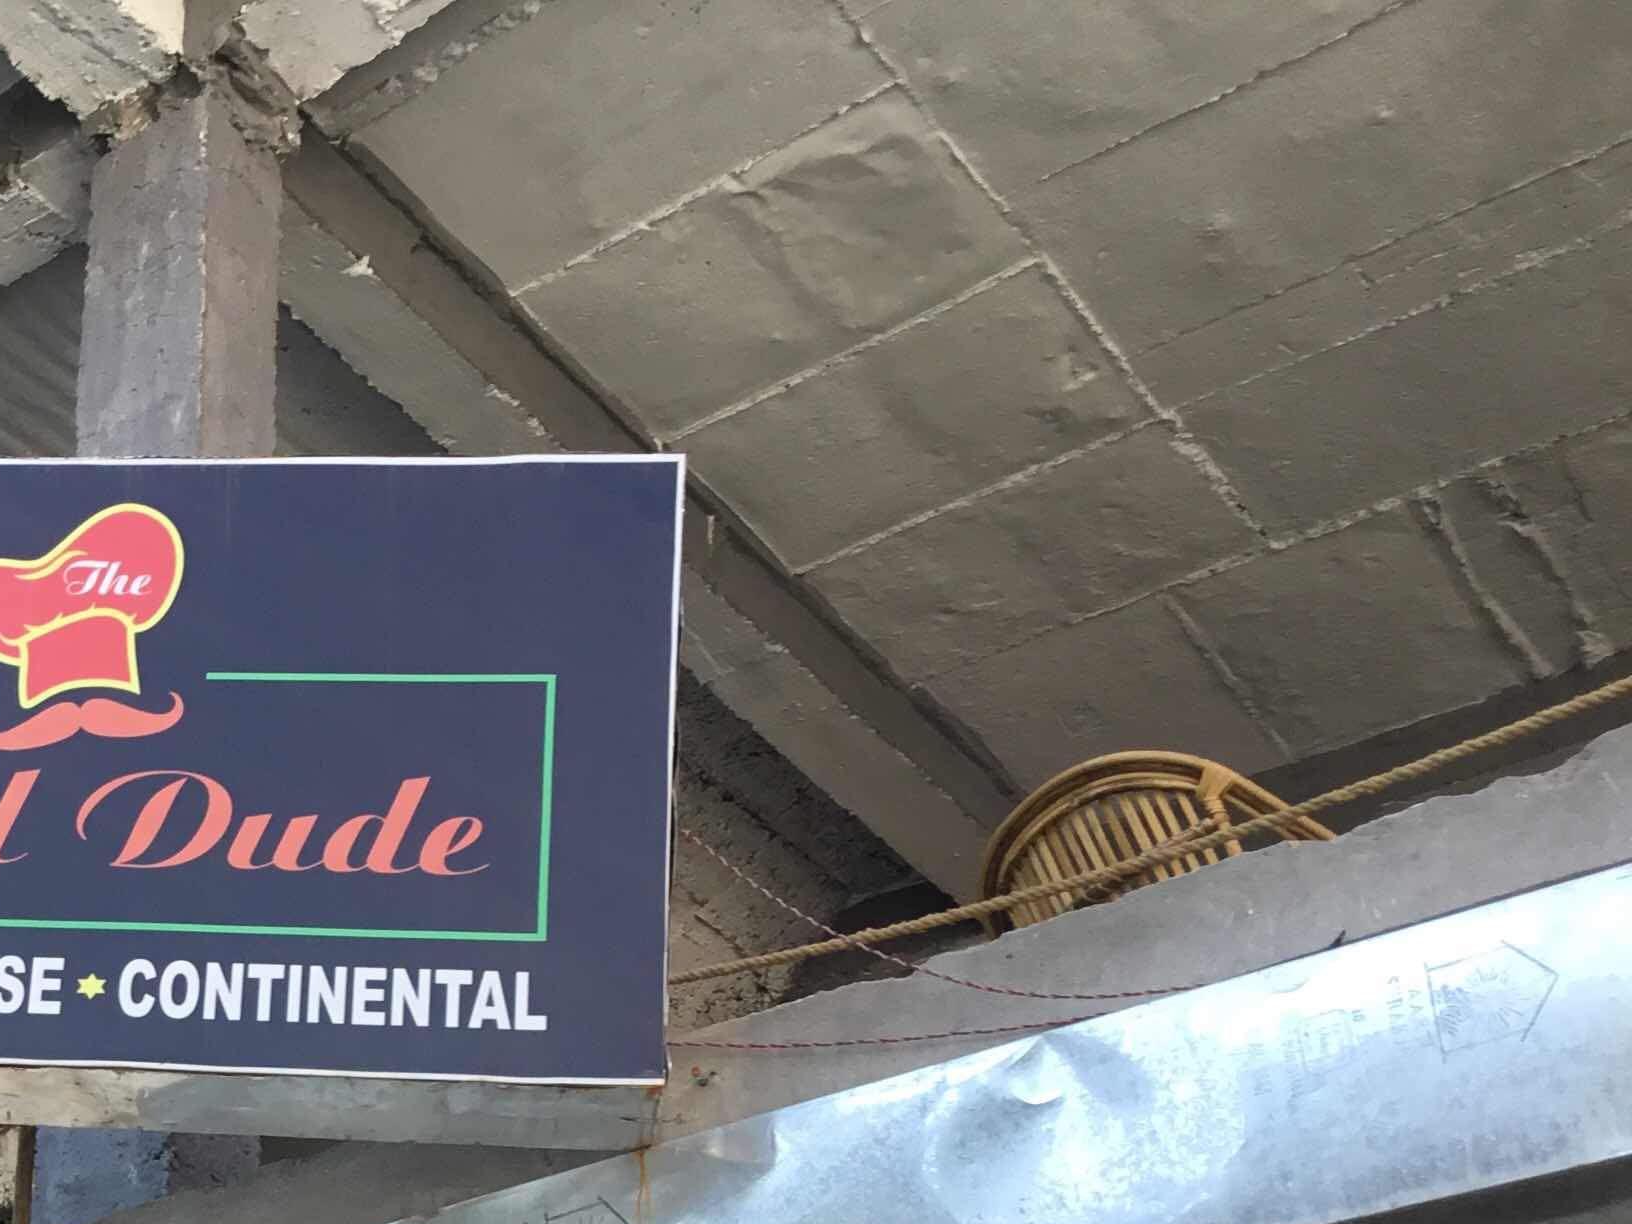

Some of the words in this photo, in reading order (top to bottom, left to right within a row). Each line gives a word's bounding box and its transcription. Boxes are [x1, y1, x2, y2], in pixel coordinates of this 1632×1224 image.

[63, 559, 153, 597] The
[75, 770, 489, 876] Dude
[118, 958, 548, 1031] CONTINENTAL
